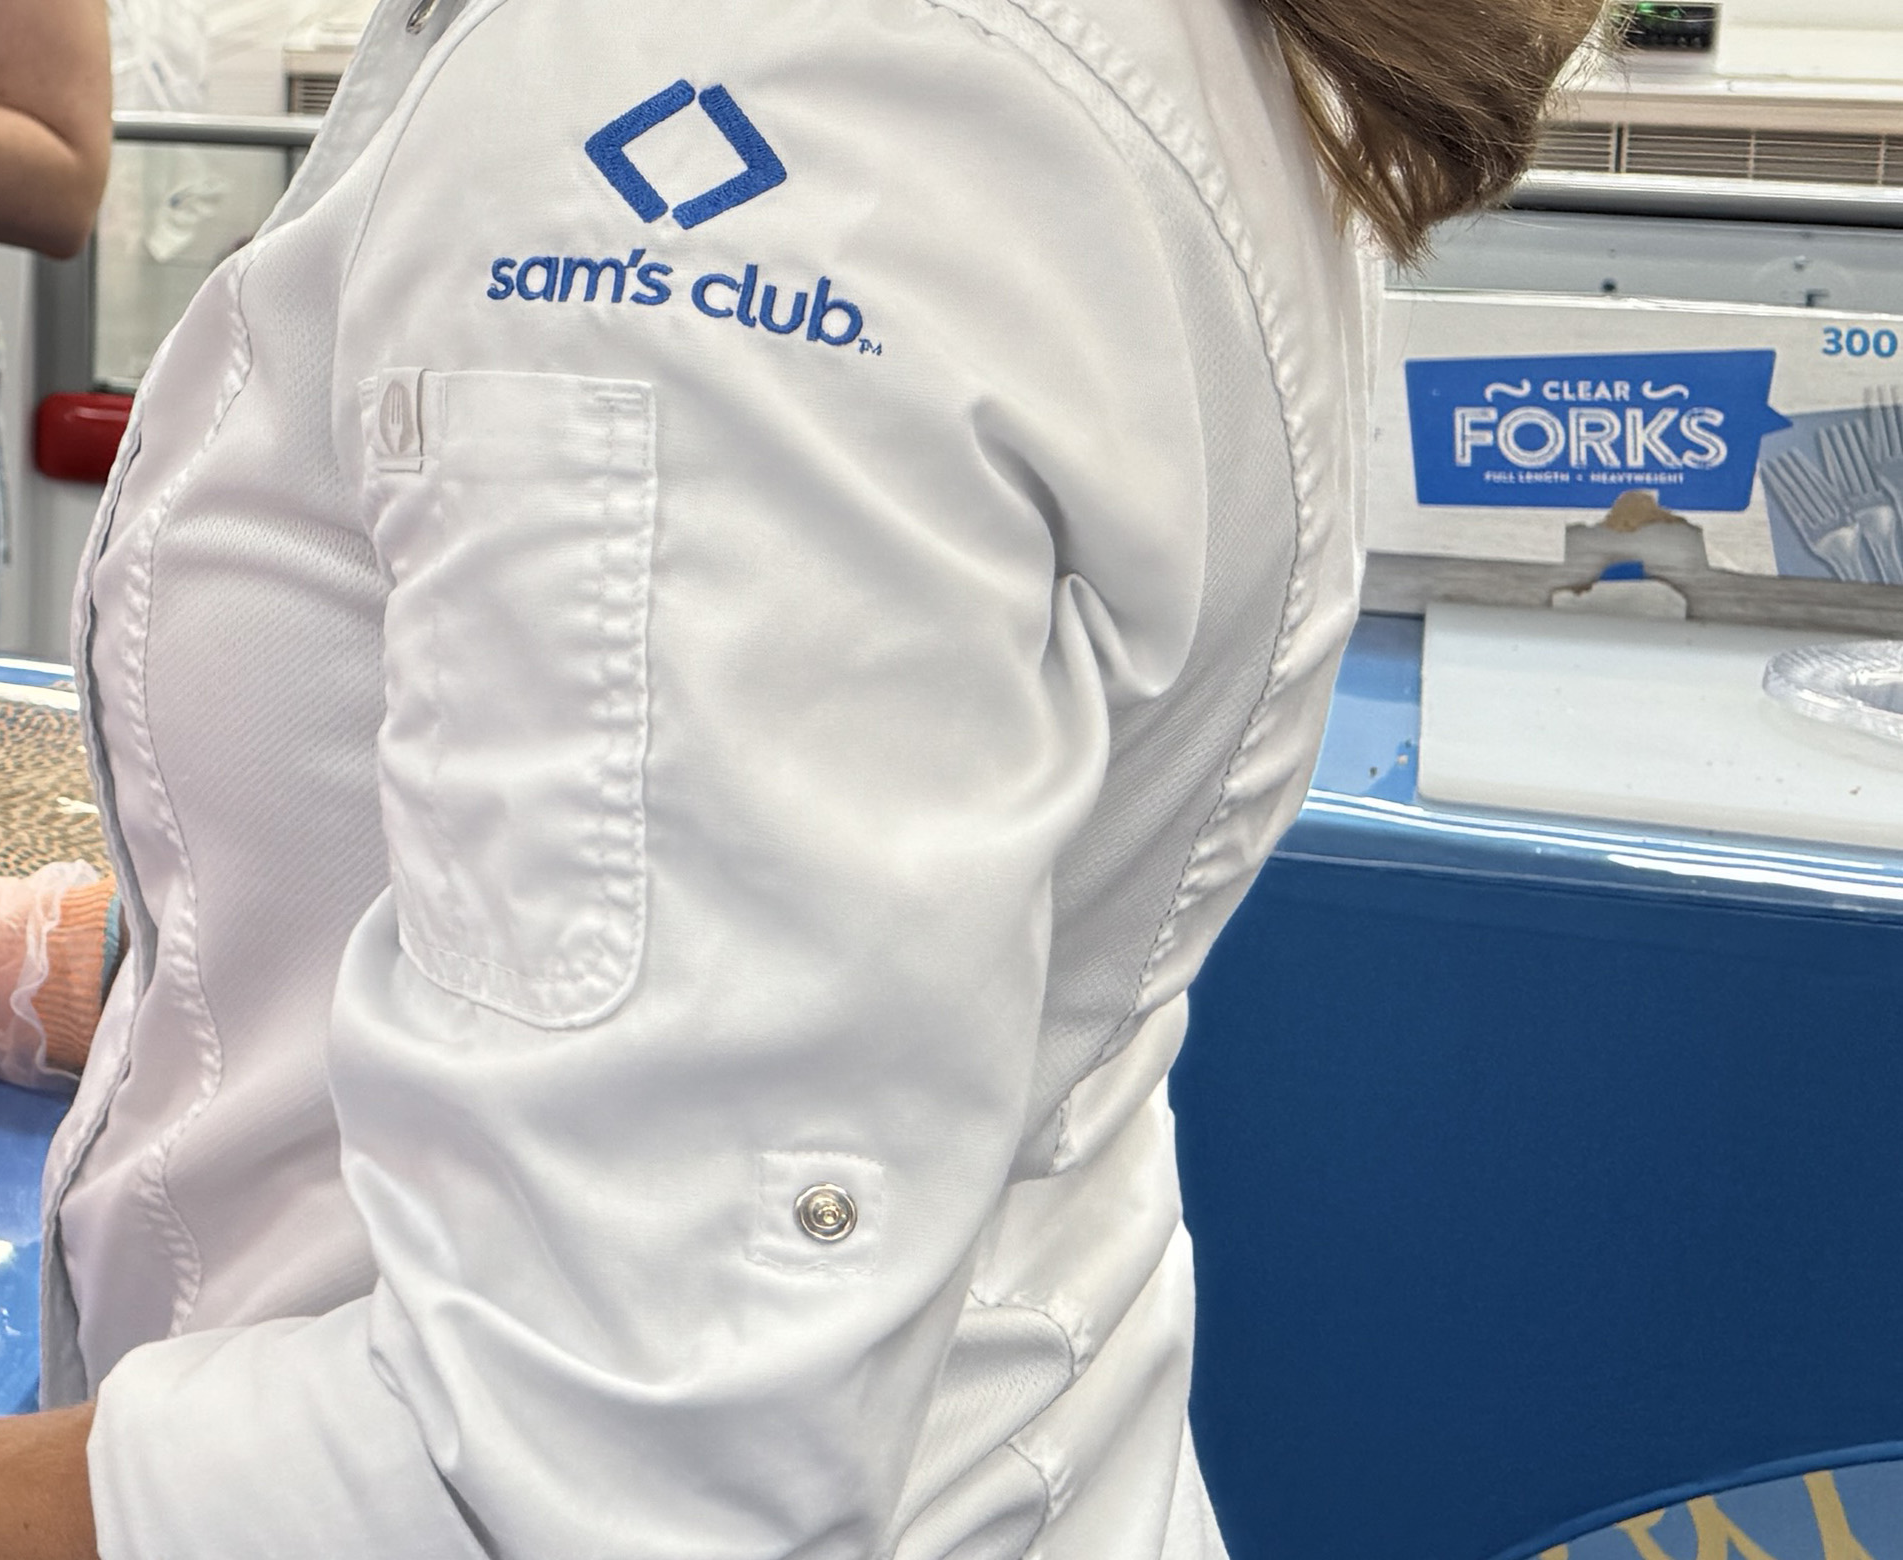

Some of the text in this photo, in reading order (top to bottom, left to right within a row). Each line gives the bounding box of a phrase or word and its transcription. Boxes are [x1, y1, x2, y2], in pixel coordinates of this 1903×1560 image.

[487, 248, 673, 305] sam's
[693, 264, 863, 346] club
[1822, 327, 1897, 358] 300
[1542, 380, 1631, 402] CLEAR
[1453, 405, 1728, 470] FORKS
[1484, 471, 1685, 485] FULL LENGTH HEAVYWEIGHT
